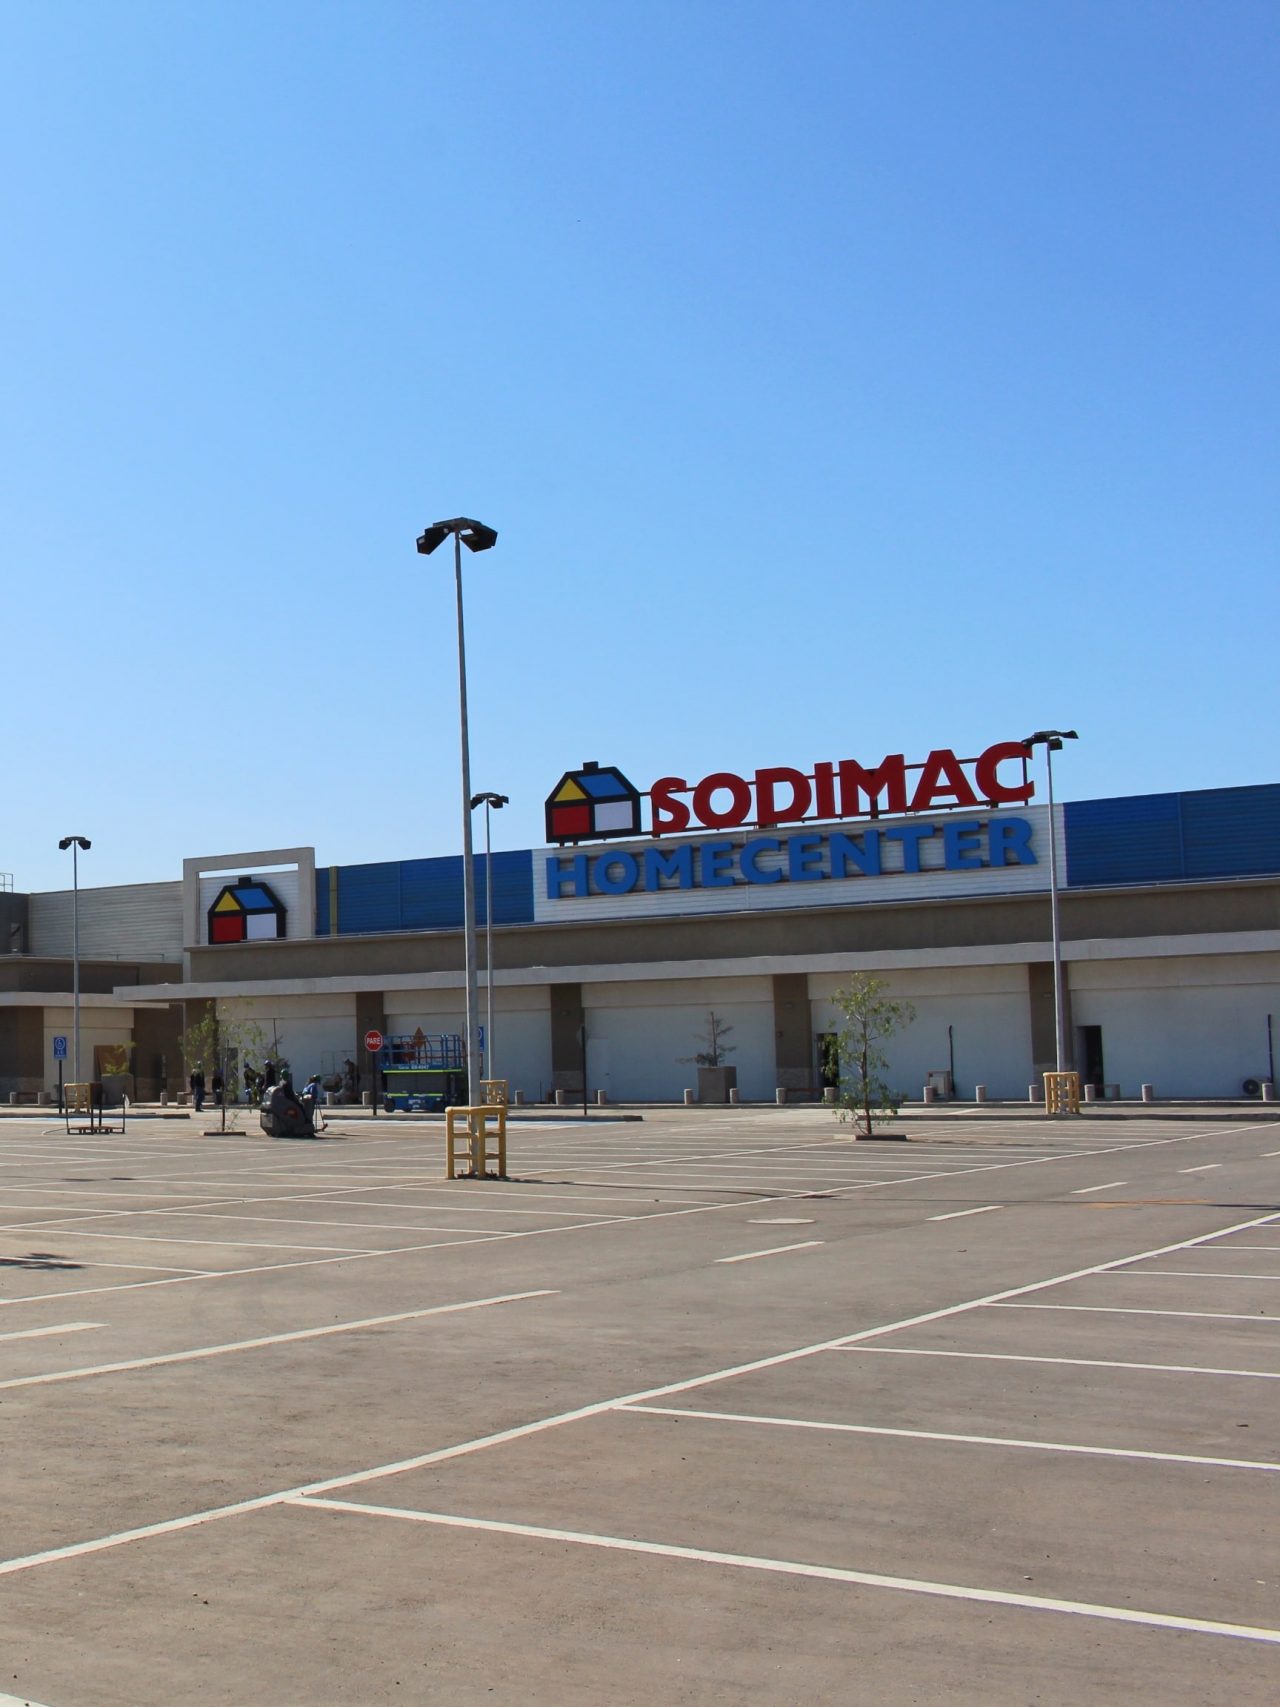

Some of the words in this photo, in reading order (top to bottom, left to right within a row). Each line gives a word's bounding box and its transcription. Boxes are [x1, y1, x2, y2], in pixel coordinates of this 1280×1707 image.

[650, 741, 1035, 833] SODIMAC
[546, 817, 1038, 900] HOMECENTER
[366, 1037, 381, 1045] PARE
